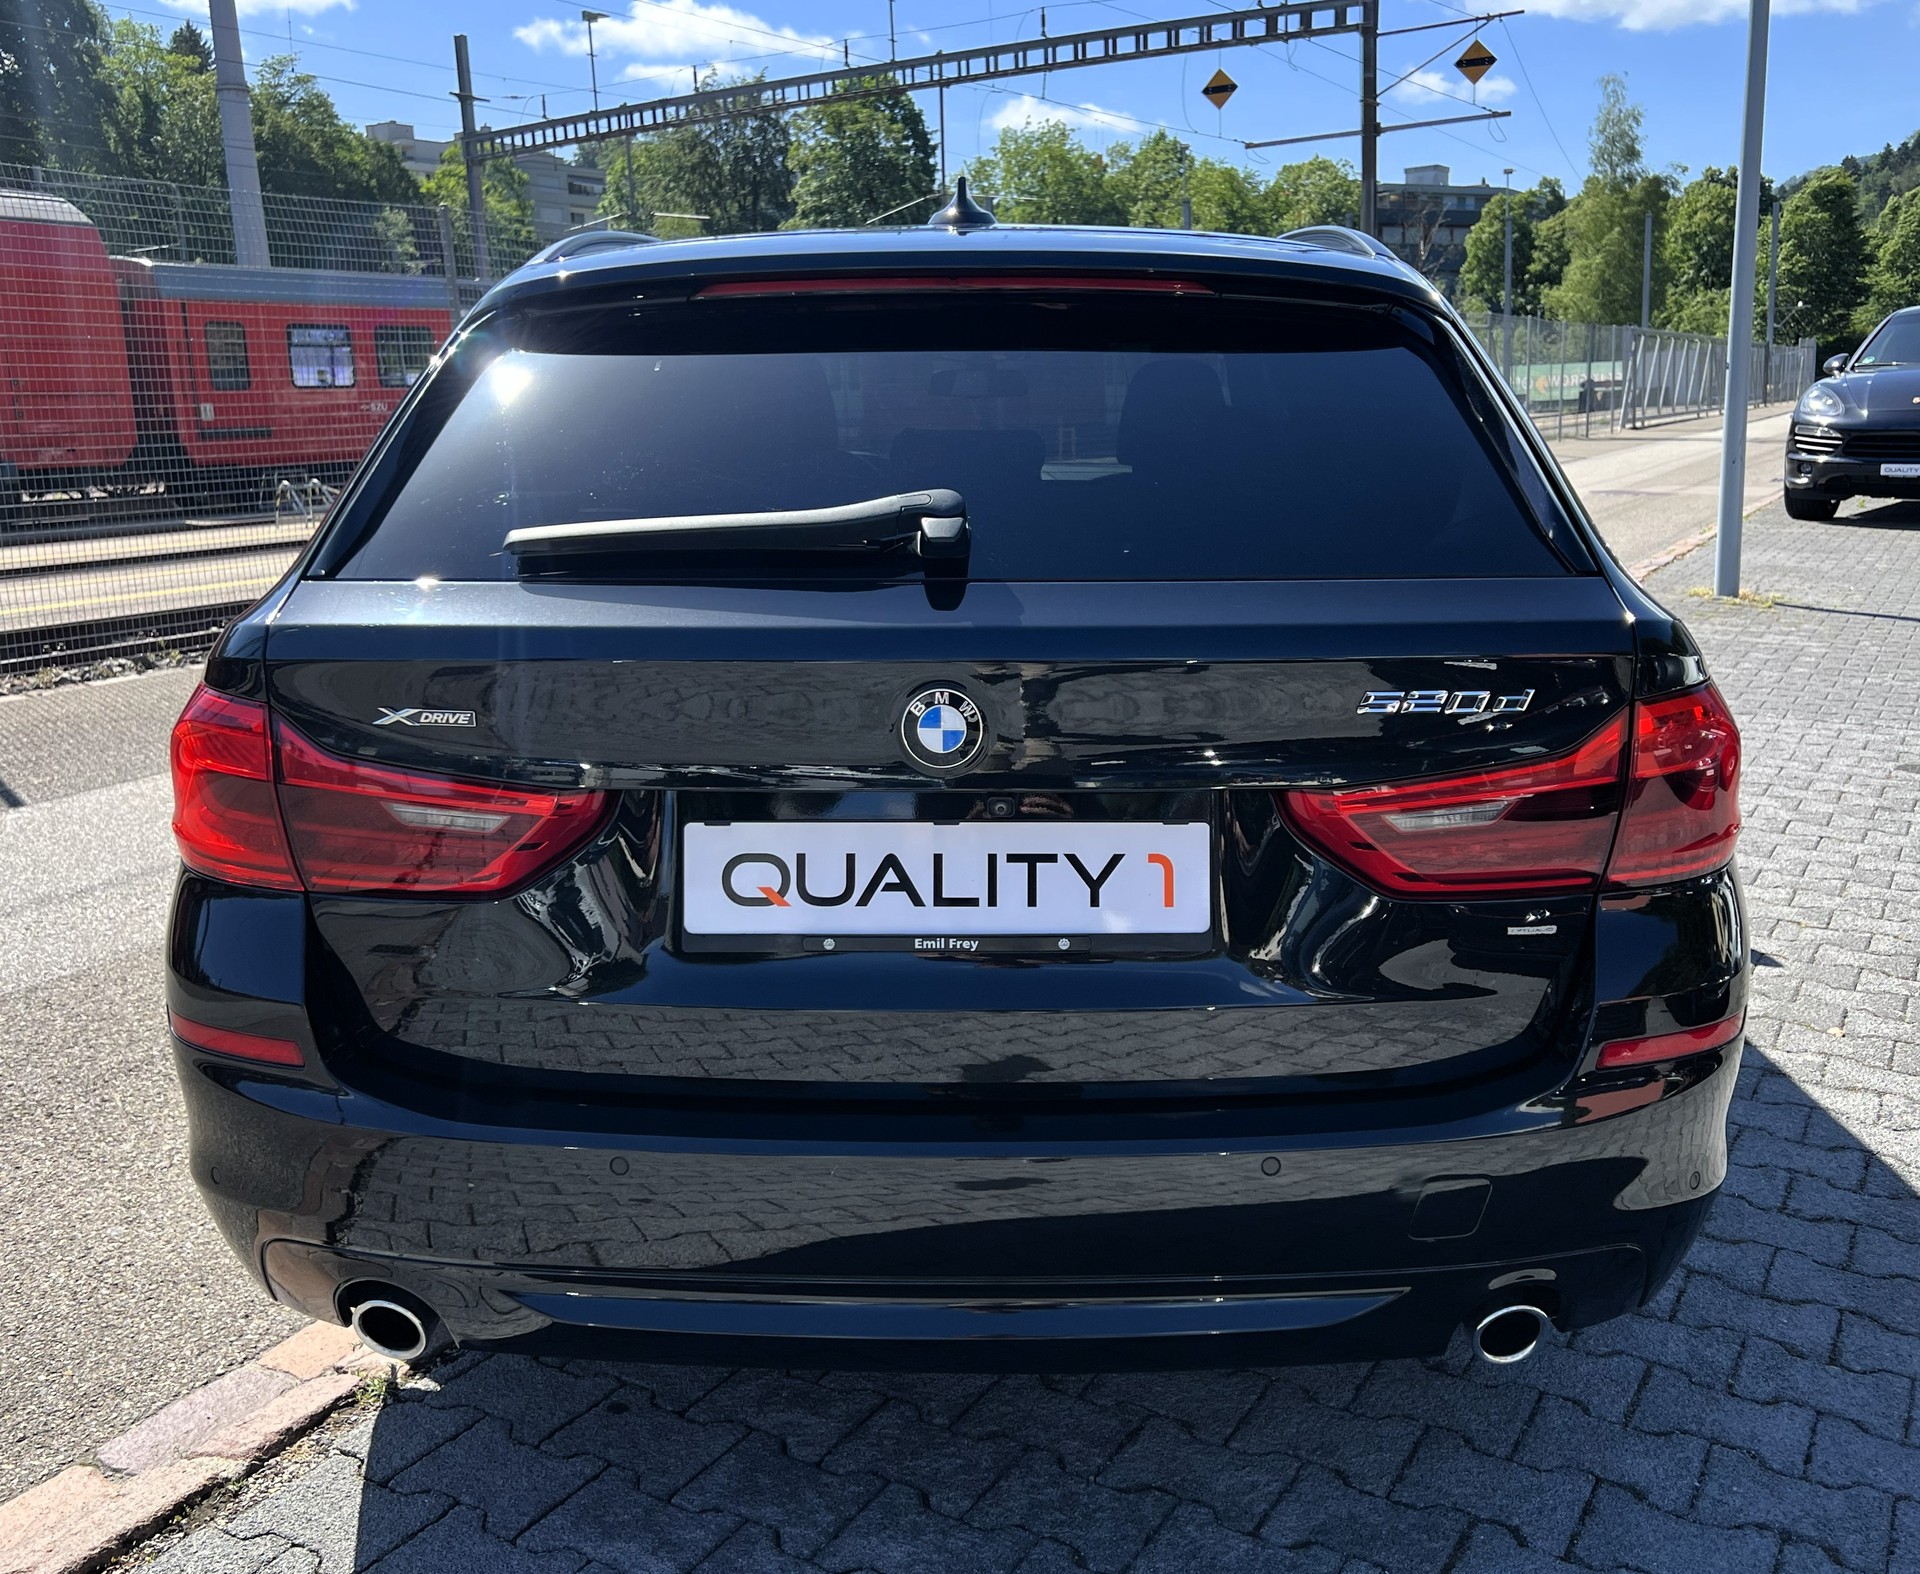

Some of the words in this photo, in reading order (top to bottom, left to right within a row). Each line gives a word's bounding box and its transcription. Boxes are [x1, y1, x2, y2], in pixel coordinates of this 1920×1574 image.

[910, 691, 979, 723] BMW
[1357, 689, 1535, 714] 520d
[721, 852, 1126, 907] QUALITY
[1147, 852, 1175, 907] 1
[914, 937, 945, 949] Emil
[948, 938, 979, 952] Frey
